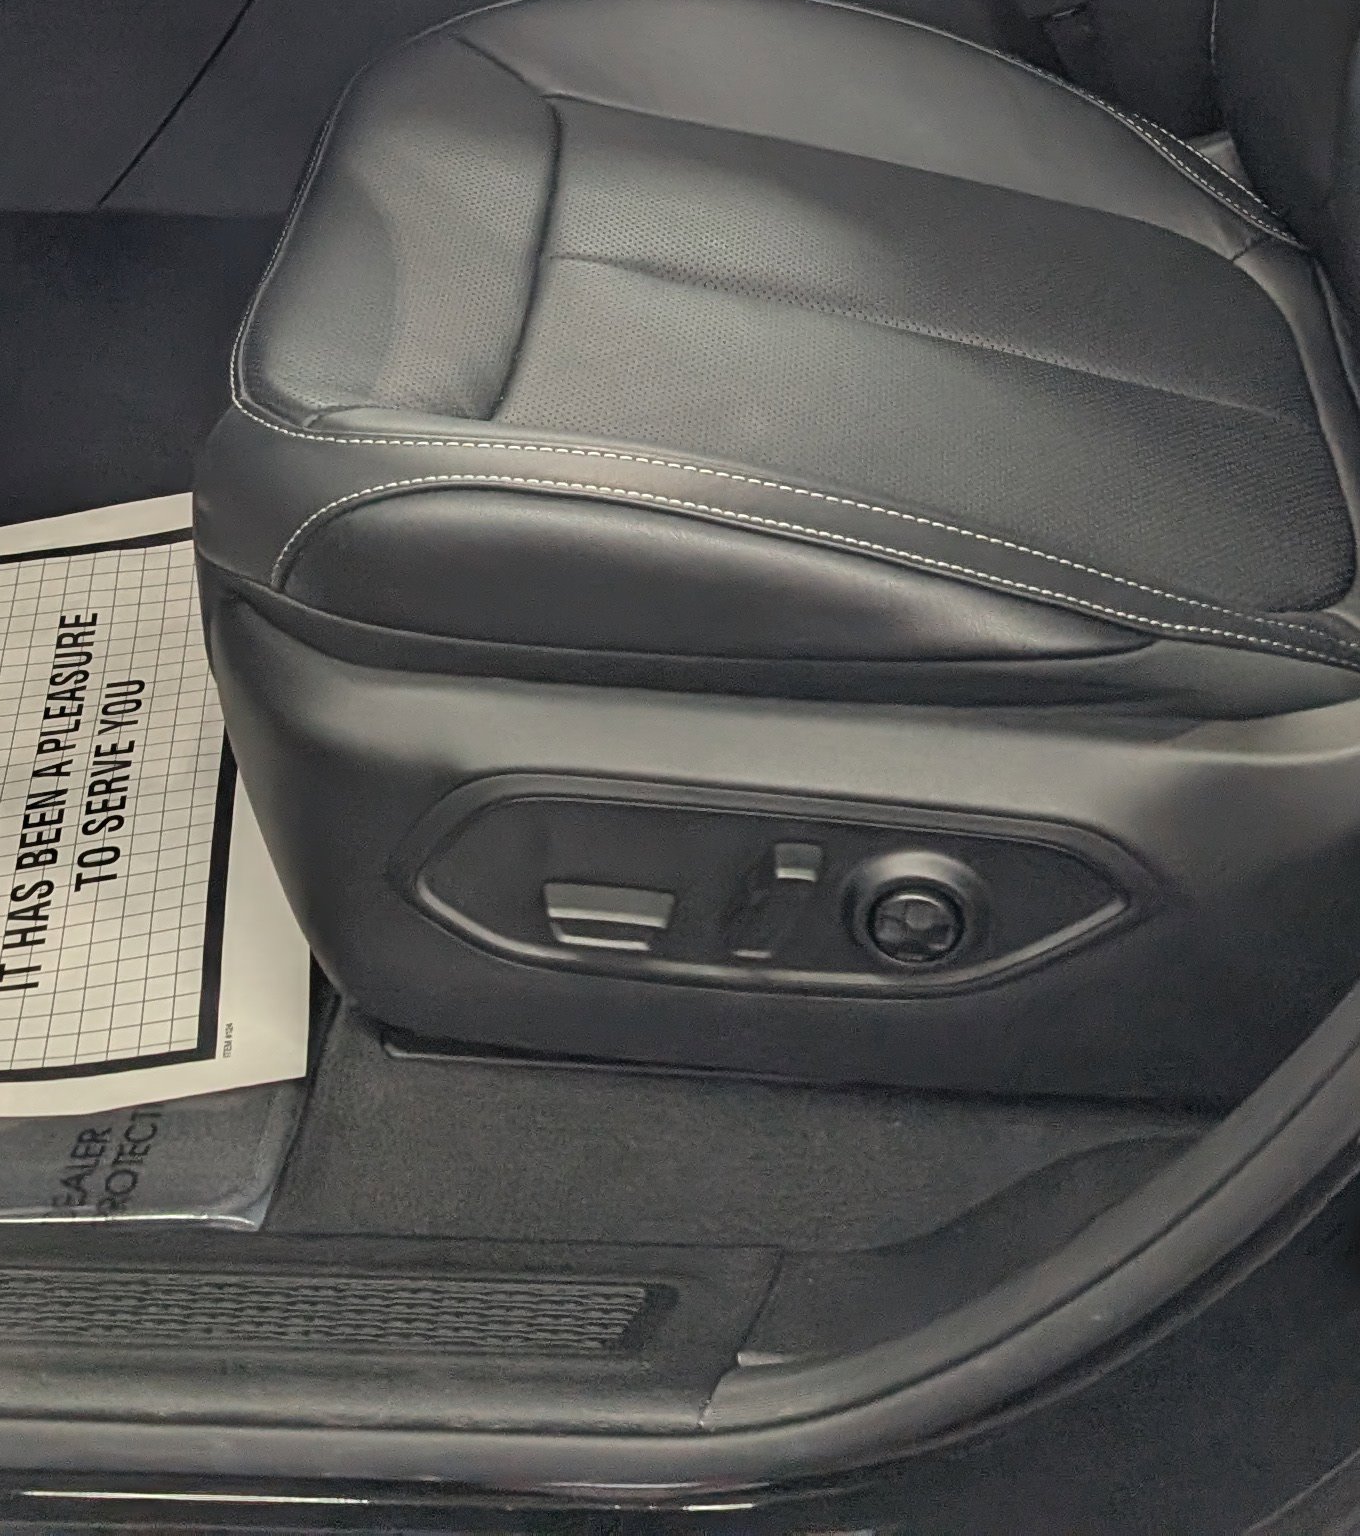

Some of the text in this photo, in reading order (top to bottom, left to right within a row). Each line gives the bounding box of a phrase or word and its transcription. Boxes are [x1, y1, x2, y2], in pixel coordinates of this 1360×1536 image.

[36, 613, 98, 755] PLEASURE
[31, 758, 73, 778] A
[74, 679, 145, 892] TO SERVE YOU
[15, 788, 68, 870] BEEN
[2, 879, 54, 950] HAS
[223, 1040, 232, 1058] ITEM
